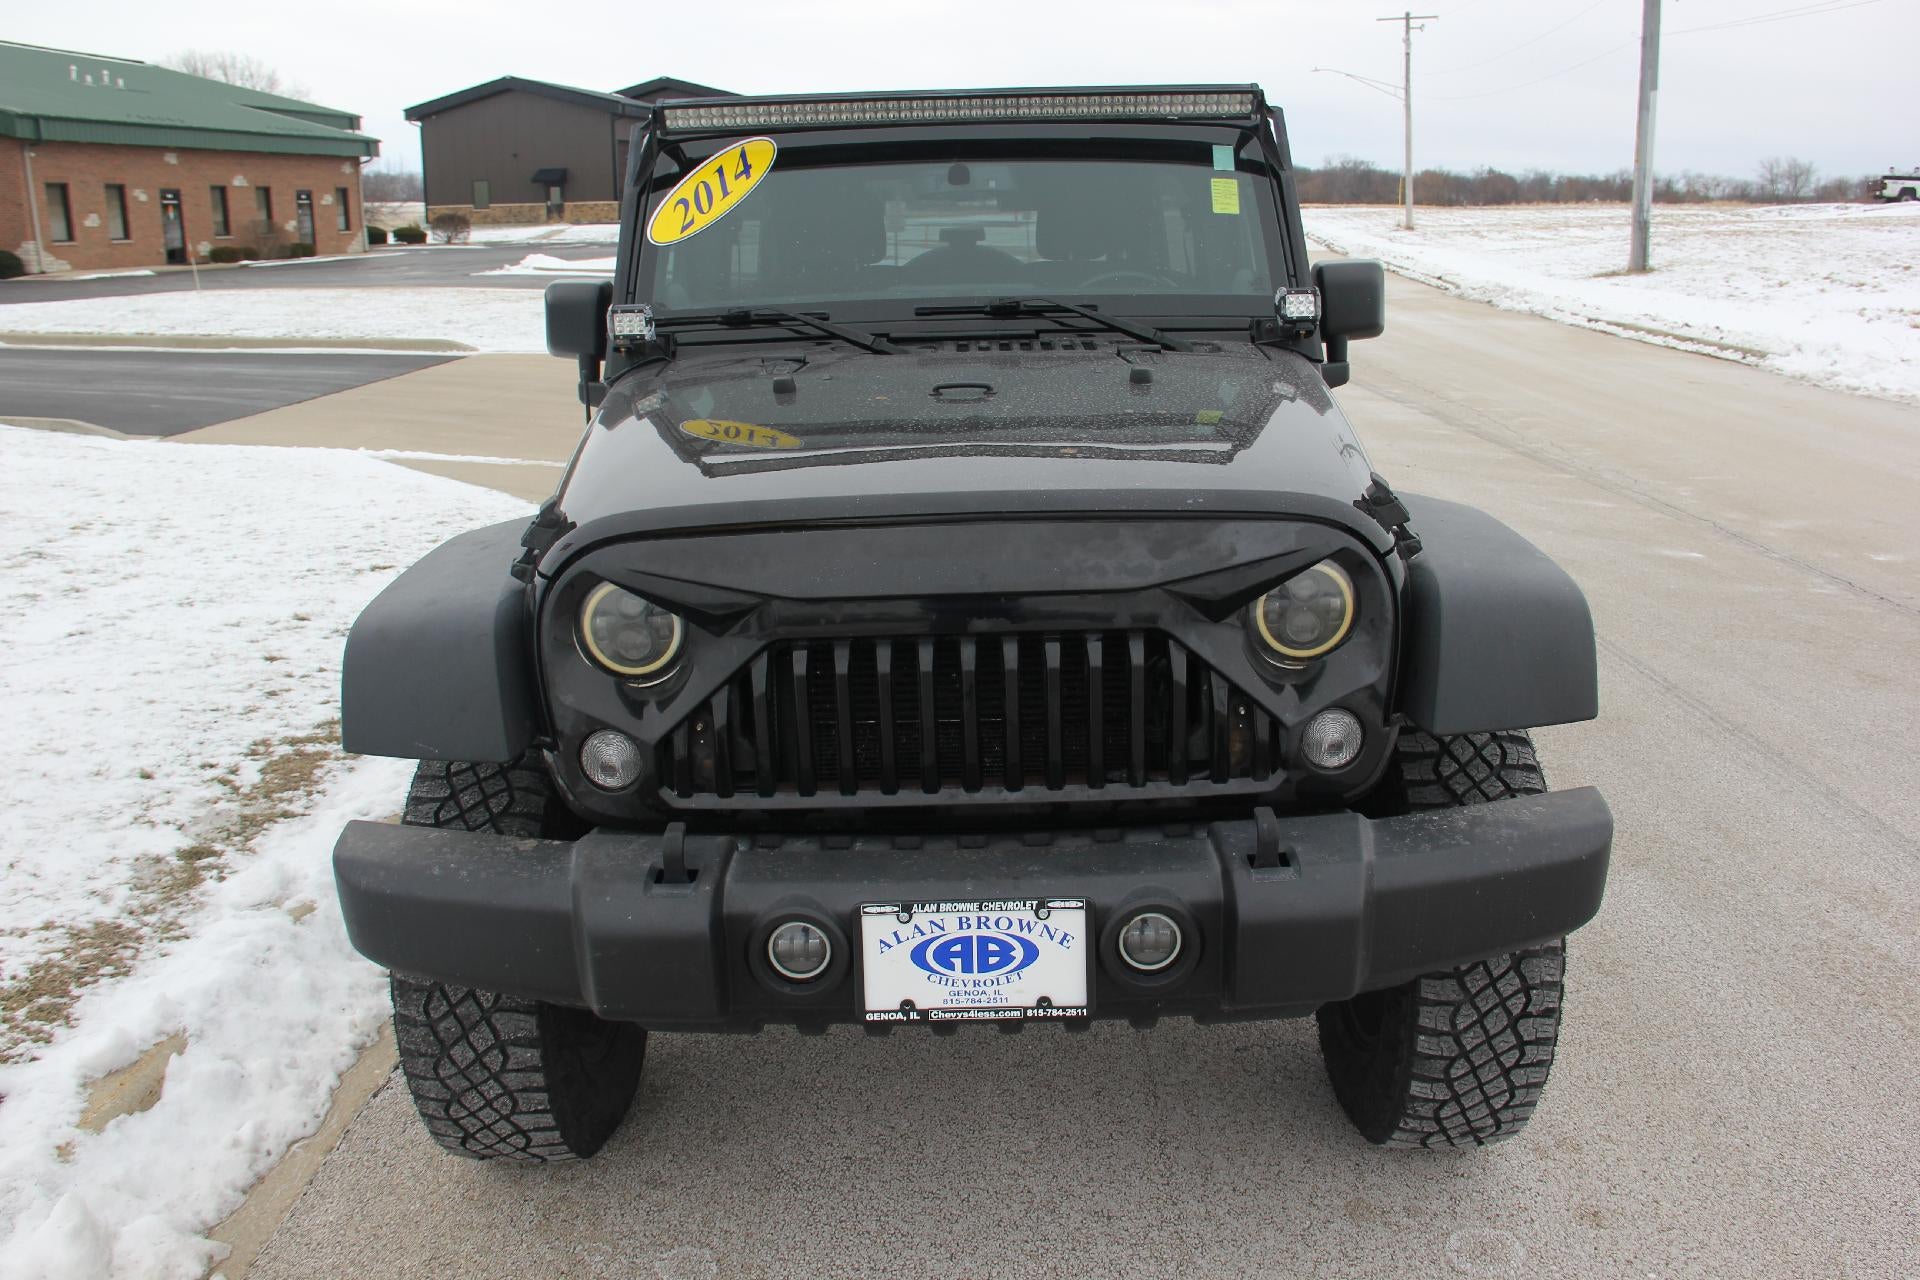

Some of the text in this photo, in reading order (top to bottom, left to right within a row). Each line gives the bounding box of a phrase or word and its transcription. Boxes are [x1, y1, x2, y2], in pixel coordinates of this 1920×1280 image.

[674, 147, 752, 234] 2014
[912, 903, 936, 913] ALAN
[939, 902, 980, 912] BROWNE
[982, 900, 1038, 911] CHEVROLET
[879, 915, 1075, 954] ALAN BROWNE
[933, 935, 1016, 974] AB
[927, 971, 1023, 988] CHEVROLET
[942, 997, 1008, 1005] 815-784-2511
[866, 1011, 920, 1020] GENOA, IL
[930, 1010, 1021, 1019] Chevys4less.com
[1027, 1008, 1087, 1017] 815-784-2511
